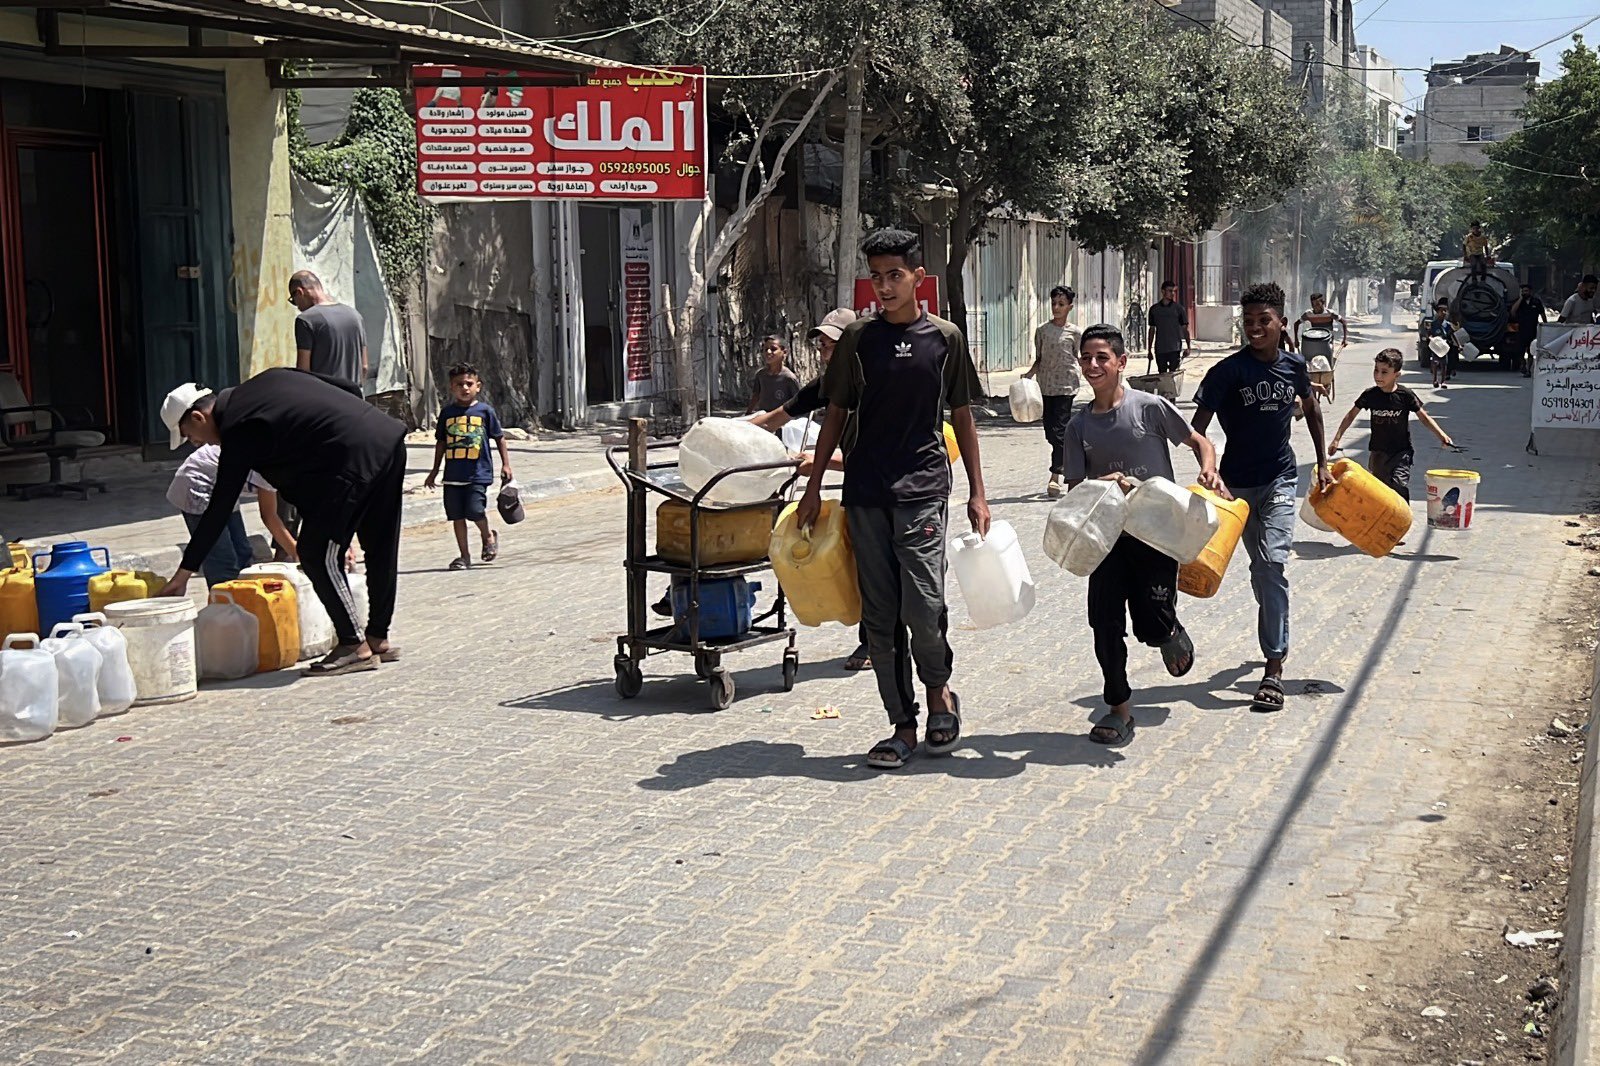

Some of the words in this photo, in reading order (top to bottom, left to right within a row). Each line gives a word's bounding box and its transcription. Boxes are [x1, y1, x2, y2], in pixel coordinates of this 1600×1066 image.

[486, 109, 505, 118] مولود
[506, 109, 527, 118] تسجيل
[485, 126, 502, 135] ميلاد
[503, 126, 527, 134] شهادة
[543, 101, 695, 151] الملك
[599, 162, 671, 174] 0592895005
[677, 163, 702, 177] جوال
[1546, 377, 1570, 393] البشرة
[1240, 380, 1295, 407] BOSS
